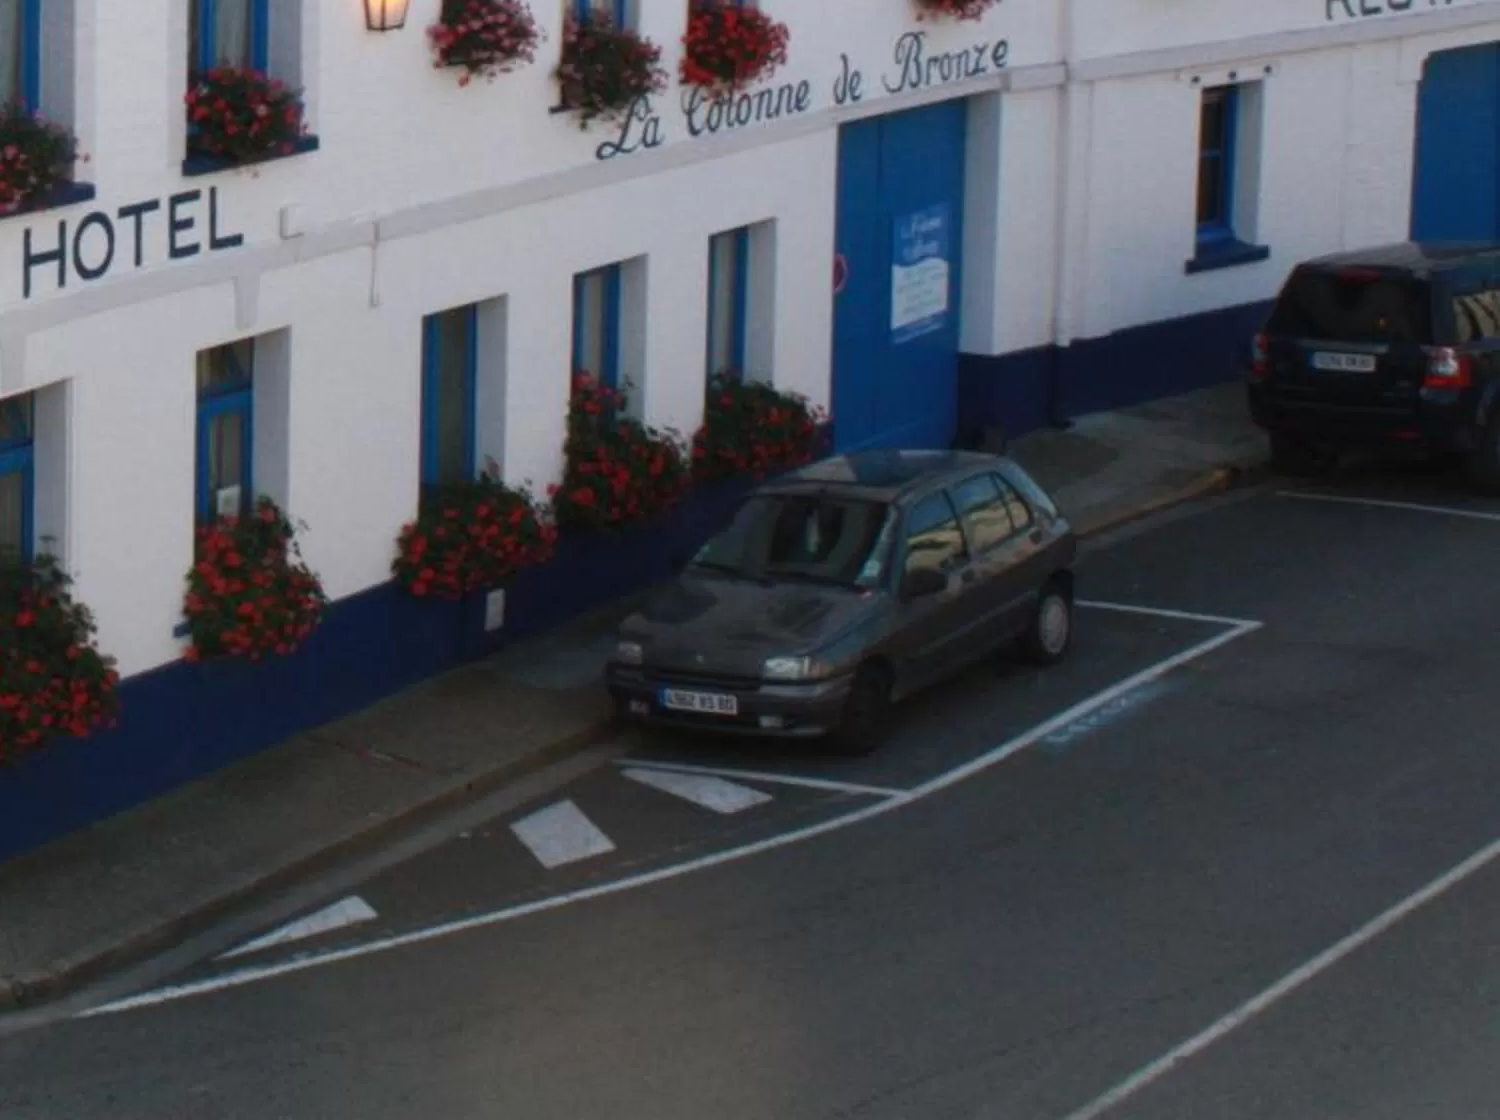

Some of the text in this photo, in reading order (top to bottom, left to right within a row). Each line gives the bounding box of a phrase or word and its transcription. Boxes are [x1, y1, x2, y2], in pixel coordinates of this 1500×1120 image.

[596, 31, 1009, 161] La Colonne de Bronze
[22, 185, 244, 299] HOTEL
